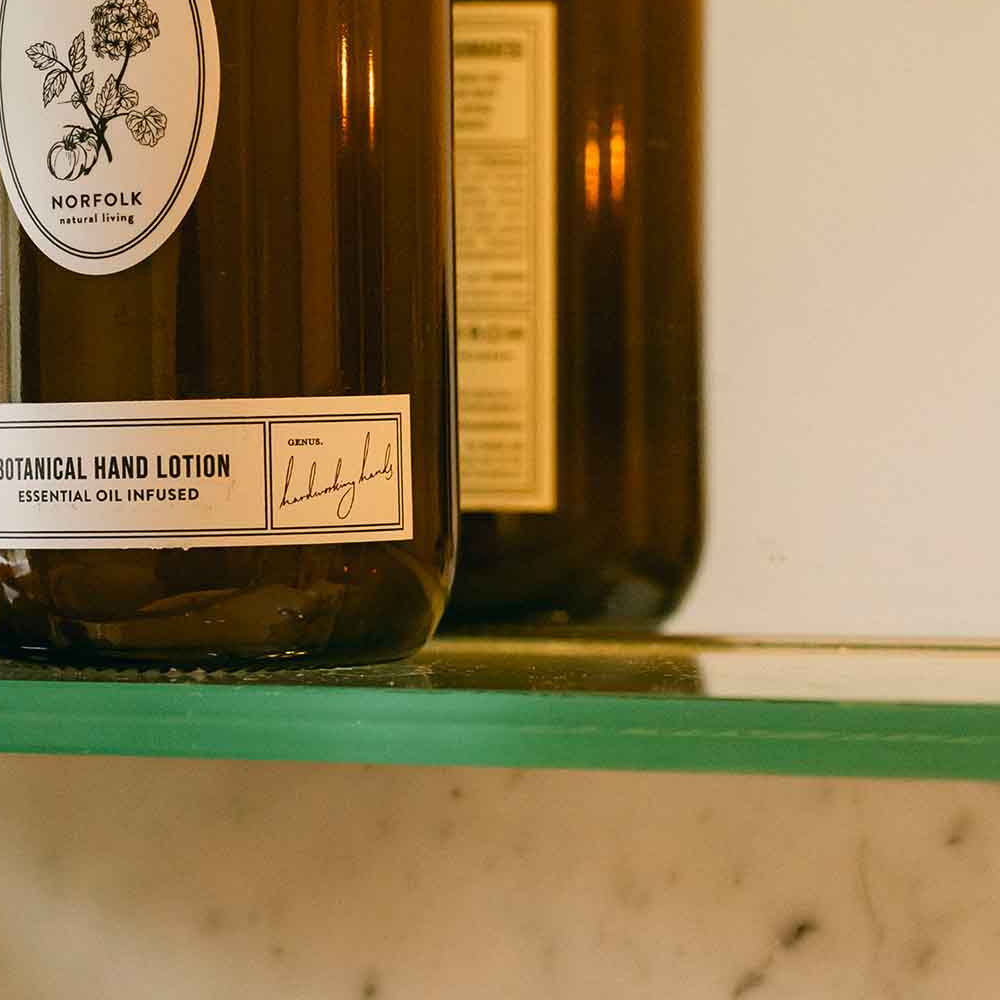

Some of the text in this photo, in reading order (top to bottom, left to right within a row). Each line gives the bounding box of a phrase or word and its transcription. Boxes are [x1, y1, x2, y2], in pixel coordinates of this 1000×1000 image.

[51, 191, 143, 210] NORFOLK
[59, 212, 135, 225] natural living
[287, 438, 324, 447] GENUS.
[94, 455, 149, 480] HAND
[156, 454, 231, 479] LOTION
[18, 488, 200, 503] ESSENTIAL OIL INFUSED
